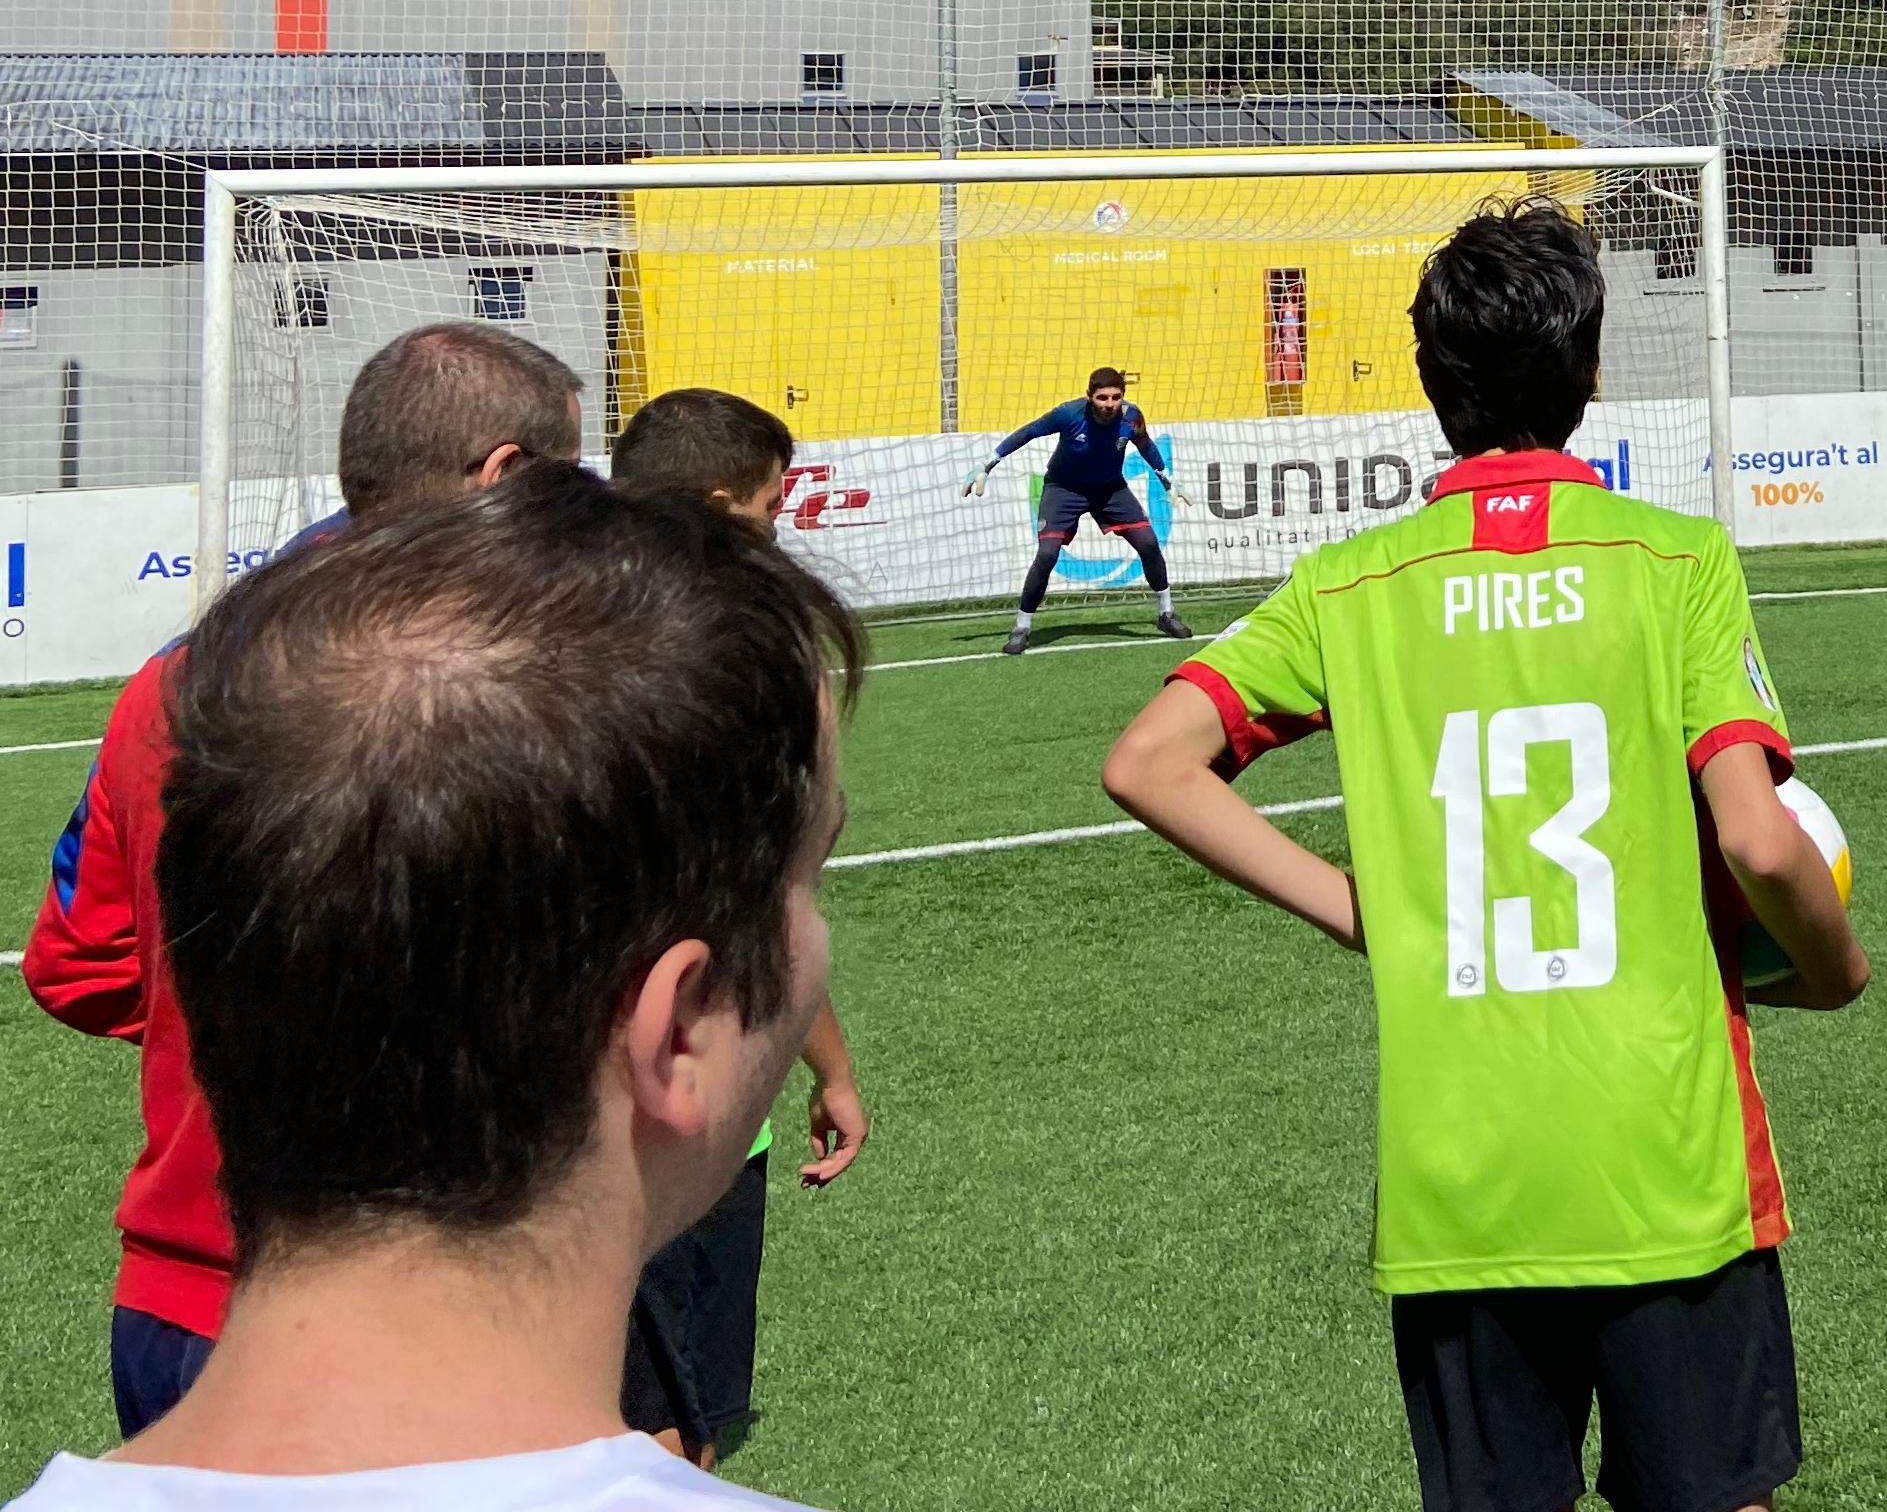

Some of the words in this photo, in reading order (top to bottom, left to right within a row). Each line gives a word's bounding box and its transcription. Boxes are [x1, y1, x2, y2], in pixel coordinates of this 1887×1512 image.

[726, 257, 820, 273] MATERIAL
[1055, 251, 1119, 264] MEDICAL
[1123, 249, 1168, 262] ROOM
[1857, 441, 1878, 464] al
[1486, 495, 1534, 513] FAF
[1751, 481, 1824, 506] 100%
[1207, 527, 1310, 554] qualitat
[1444, 565, 1585, 635] PIRES
[1430, 702, 1618, 996] 13
